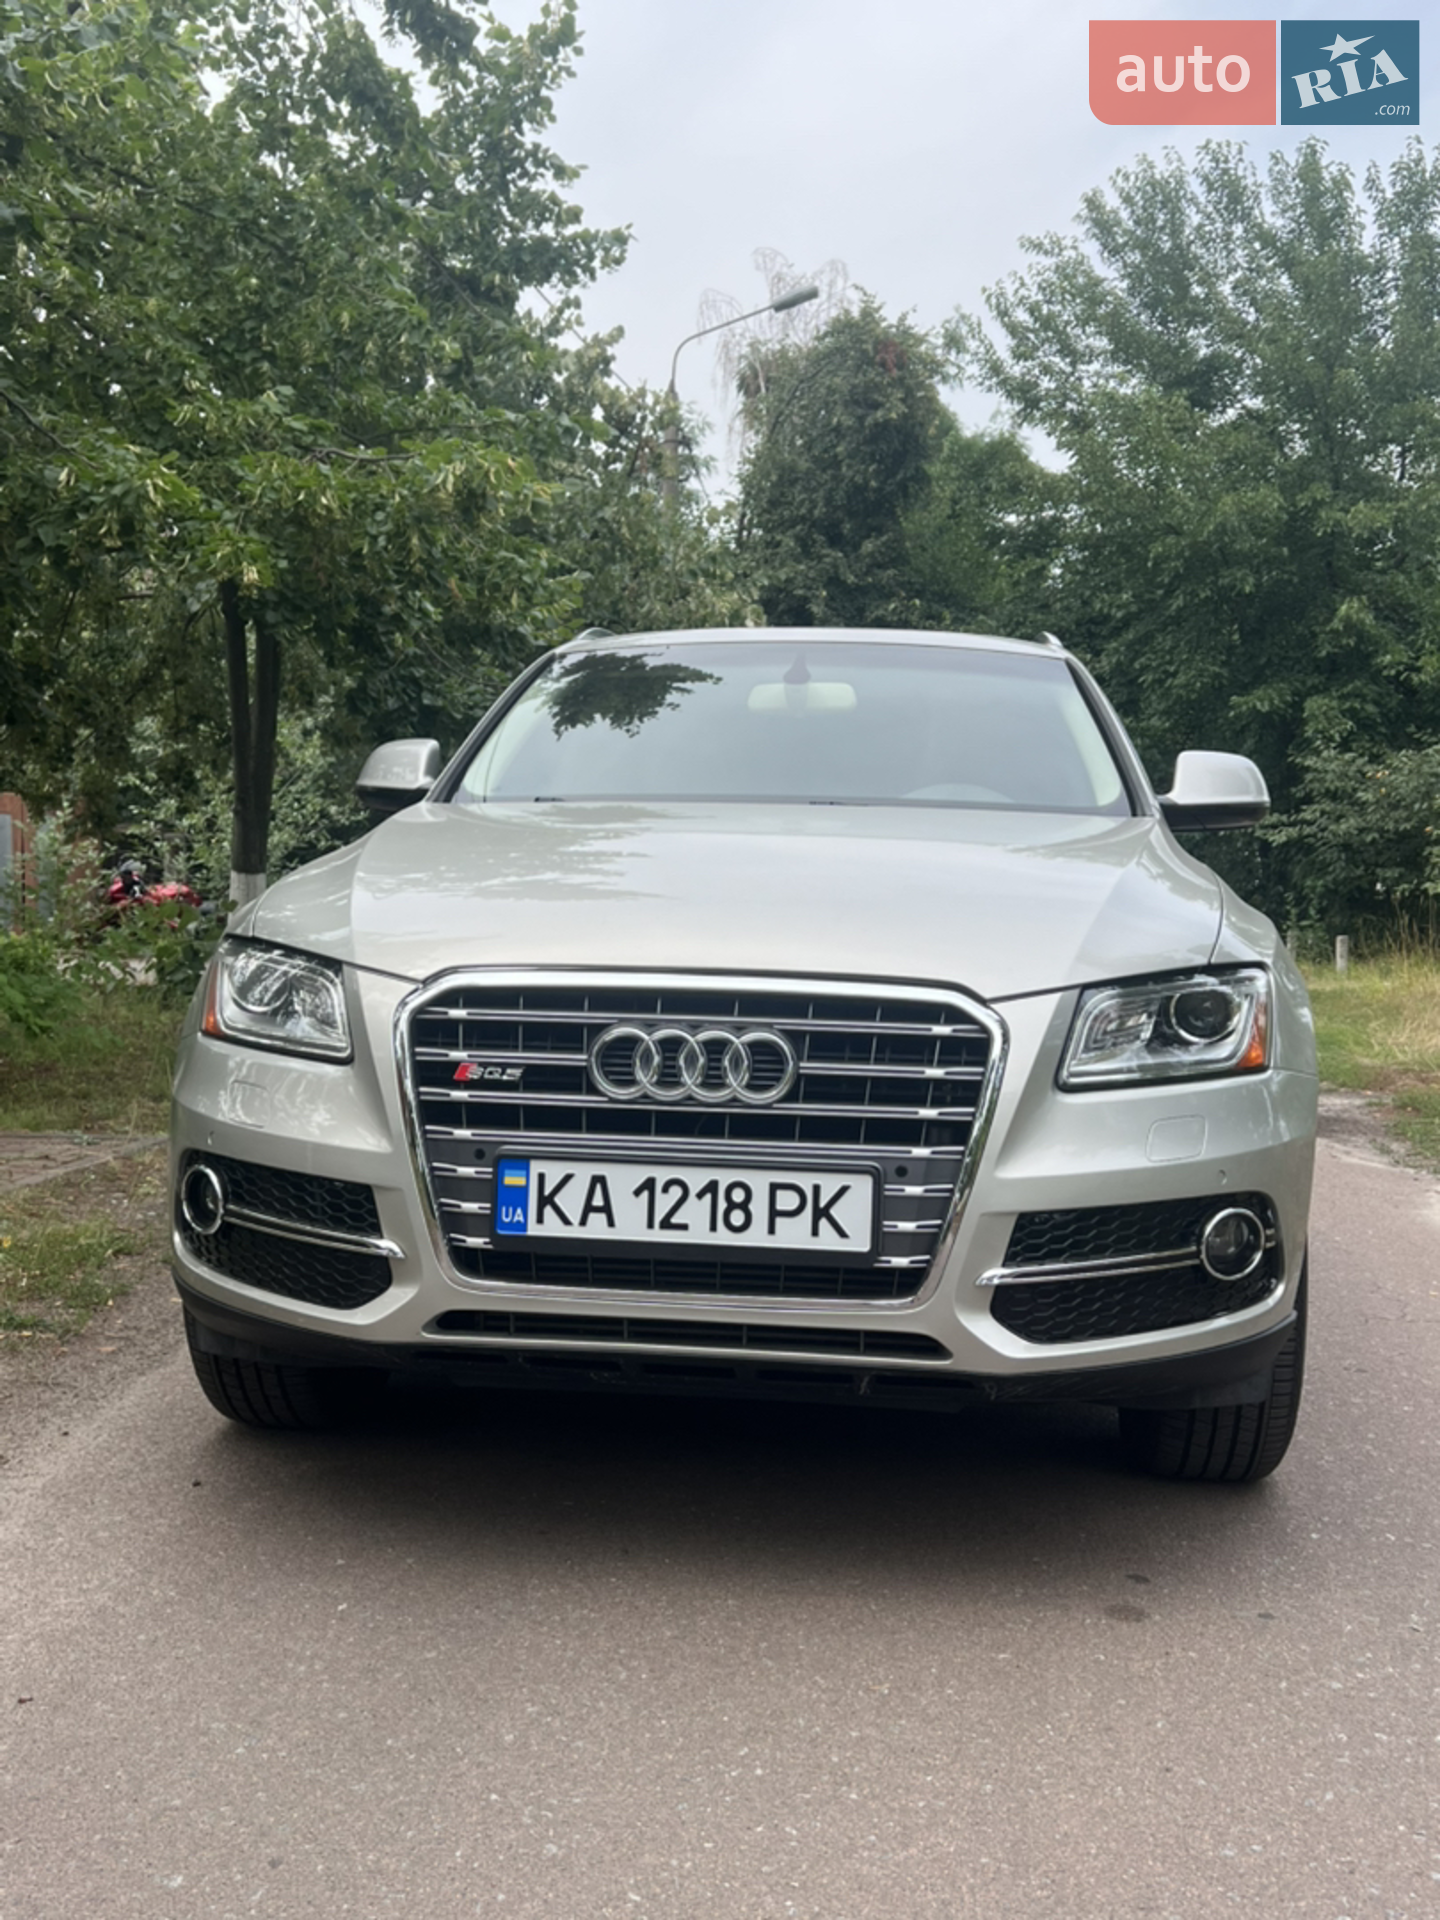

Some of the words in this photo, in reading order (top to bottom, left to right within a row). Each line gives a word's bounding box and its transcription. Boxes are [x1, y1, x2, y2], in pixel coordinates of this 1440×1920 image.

[501, 1206, 525, 1224] UA
[535, 1172, 616, 1228] KA
[632, 1176, 753, 1234] 1218
[767, 1181, 852, 1240] PK
